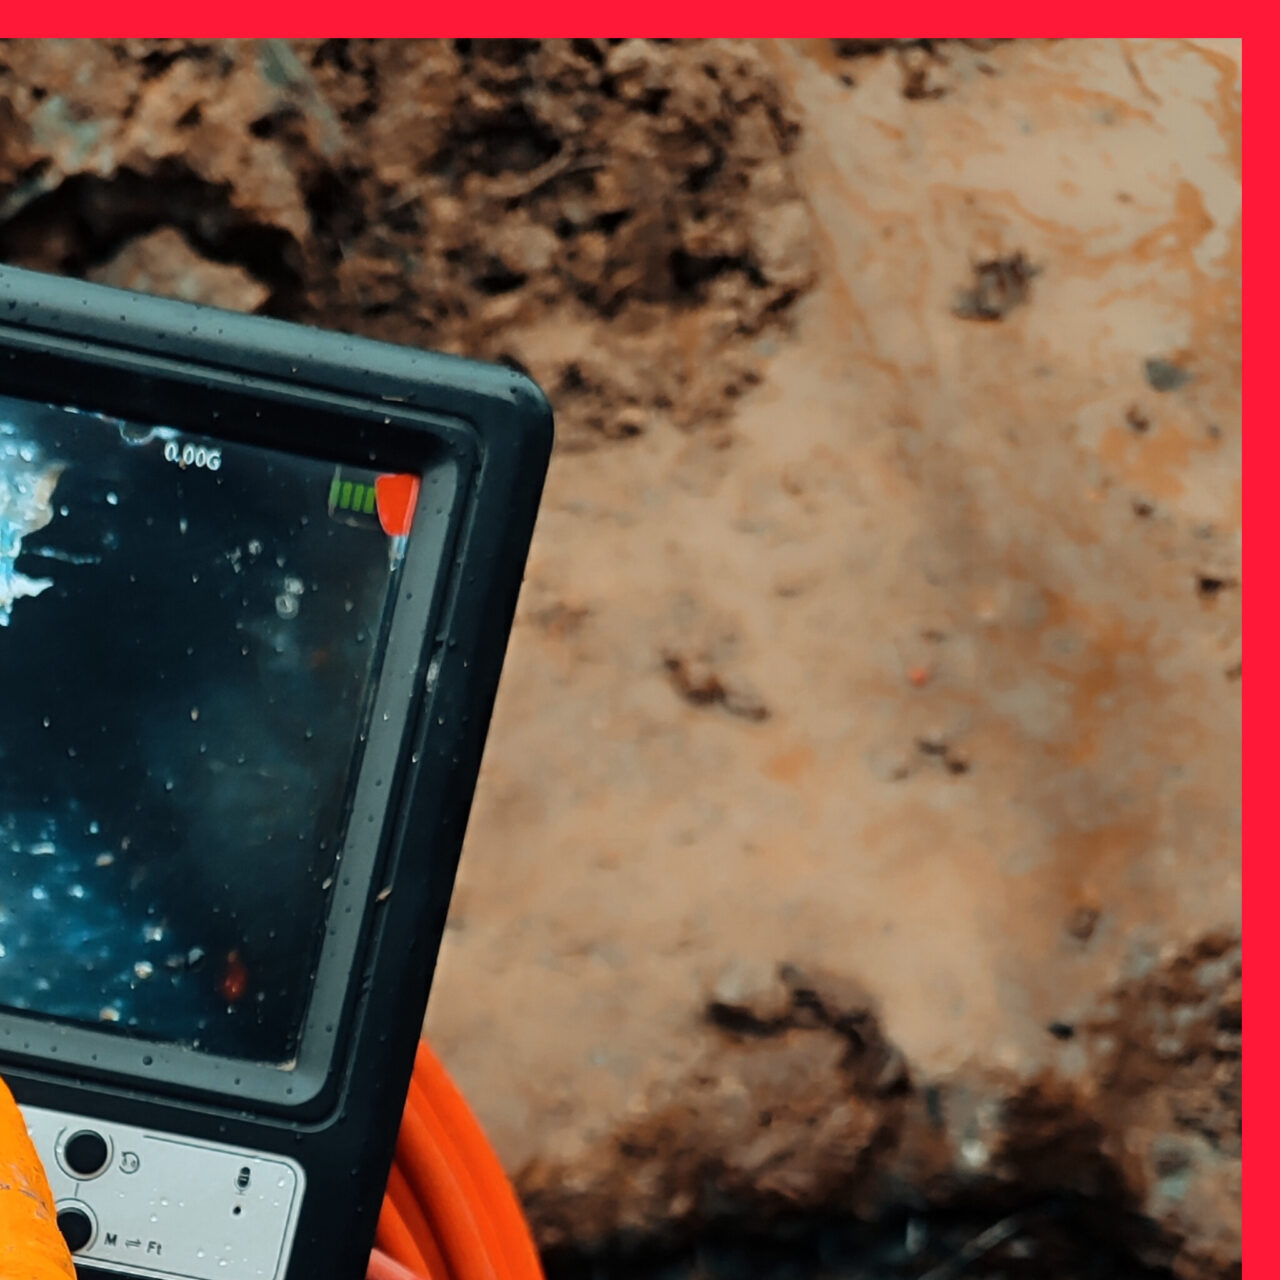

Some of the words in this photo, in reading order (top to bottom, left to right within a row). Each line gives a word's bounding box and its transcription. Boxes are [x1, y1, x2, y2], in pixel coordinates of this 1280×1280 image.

[164, 441, 221, 471] 0.00G
[103, 1232, 118, 1247] M
[146, 1241, 163, 1256] Ft
